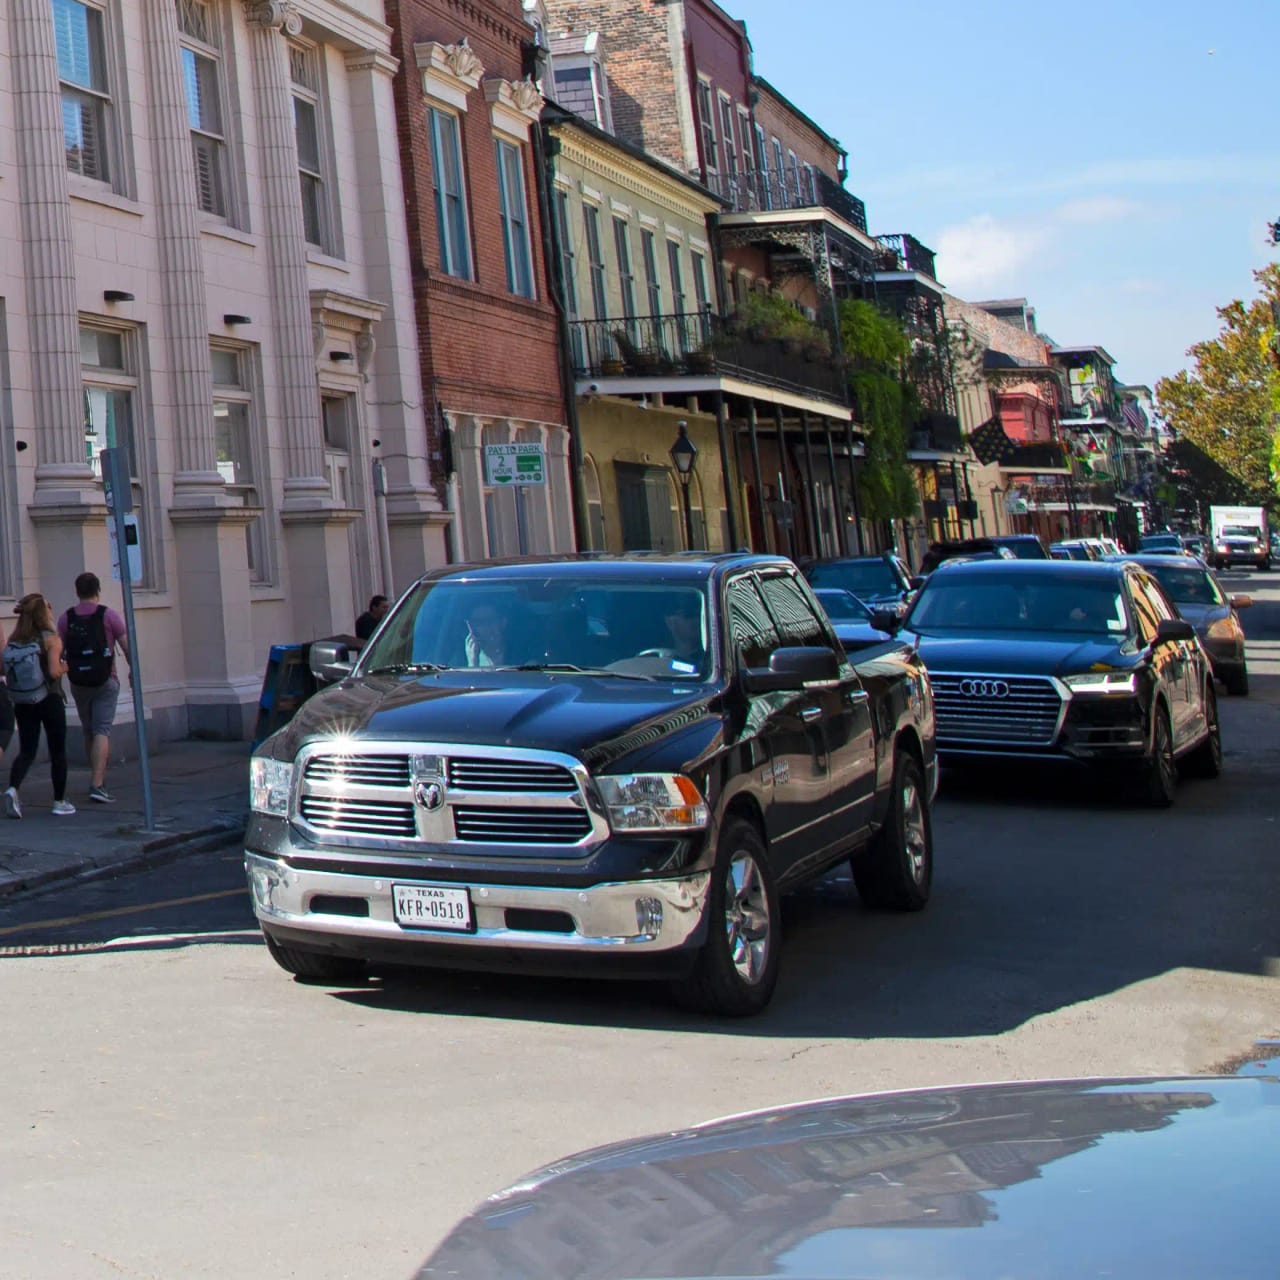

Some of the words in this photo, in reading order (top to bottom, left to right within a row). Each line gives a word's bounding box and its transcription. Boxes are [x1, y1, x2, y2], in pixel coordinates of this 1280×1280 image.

[487, 445, 502, 455] PAY
[504, 445, 517, 455] TO
[518, 444, 541, 454] PARK
[497, 455, 505, 467] 2
[416, 889, 445, 898] TEXAS
